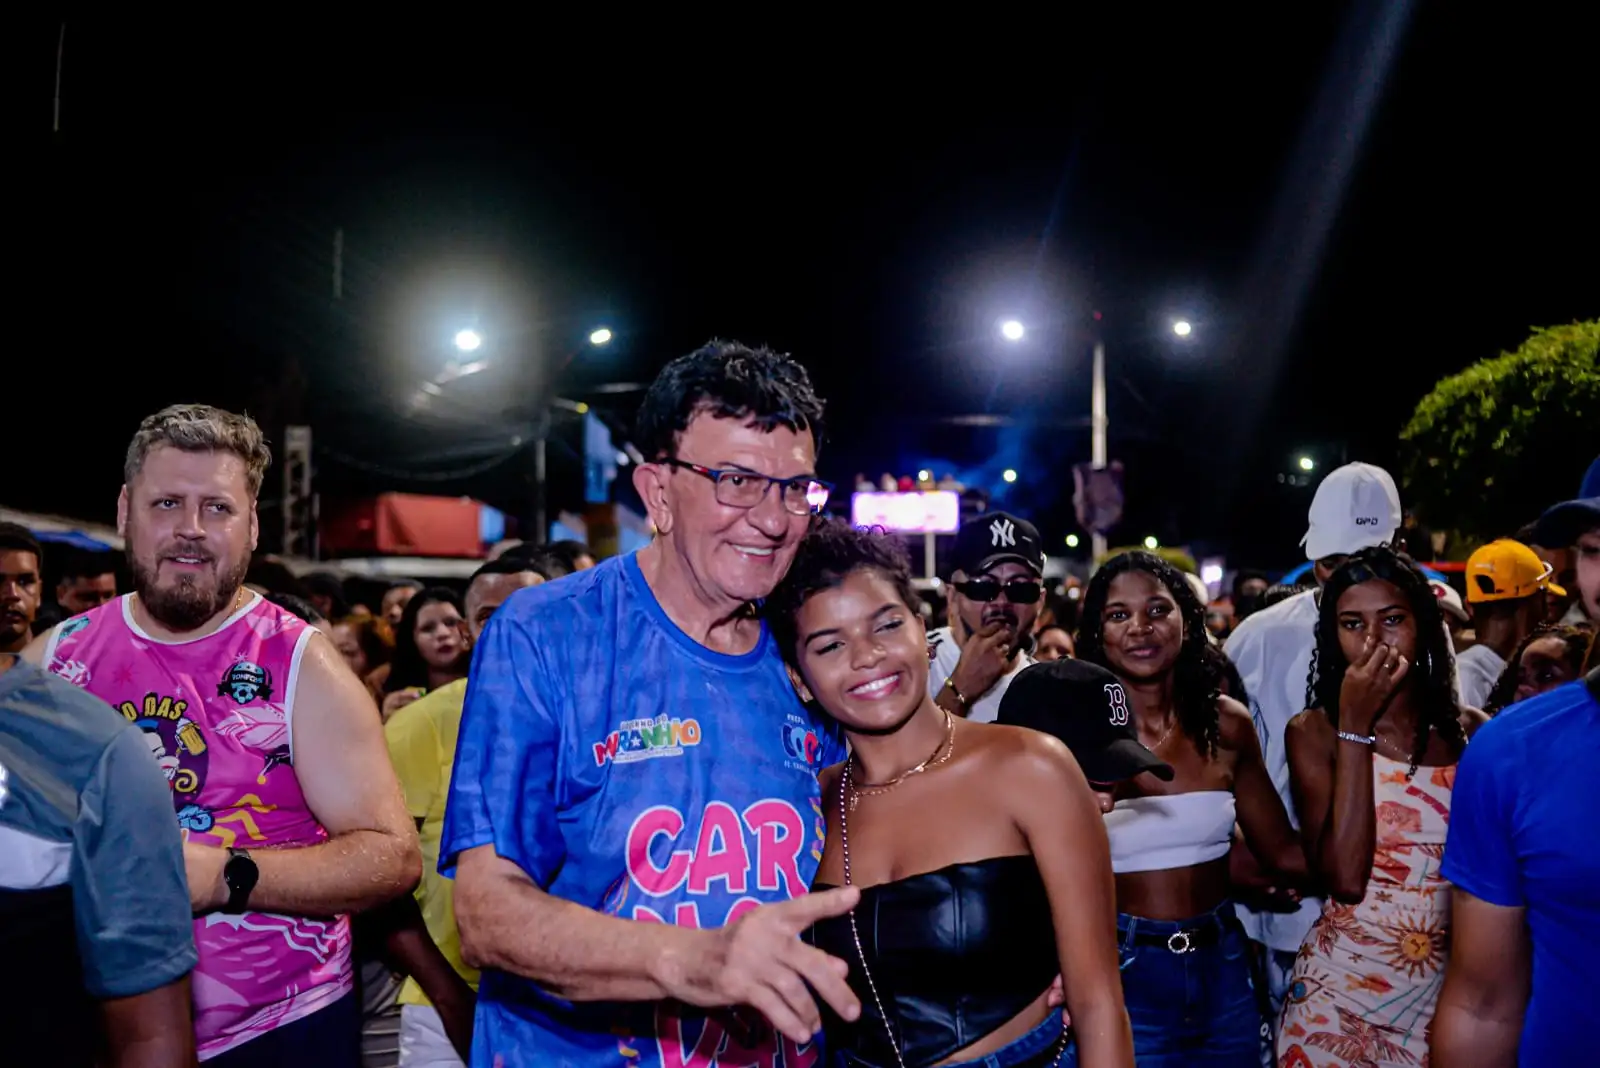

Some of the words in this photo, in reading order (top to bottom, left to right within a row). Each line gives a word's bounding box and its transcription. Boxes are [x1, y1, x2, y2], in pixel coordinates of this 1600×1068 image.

[989, 518, 1016, 548] NY
[143, 694, 188, 721] DAS
[1103, 683, 1129, 726] B
[625, 798, 809, 900] CAR
